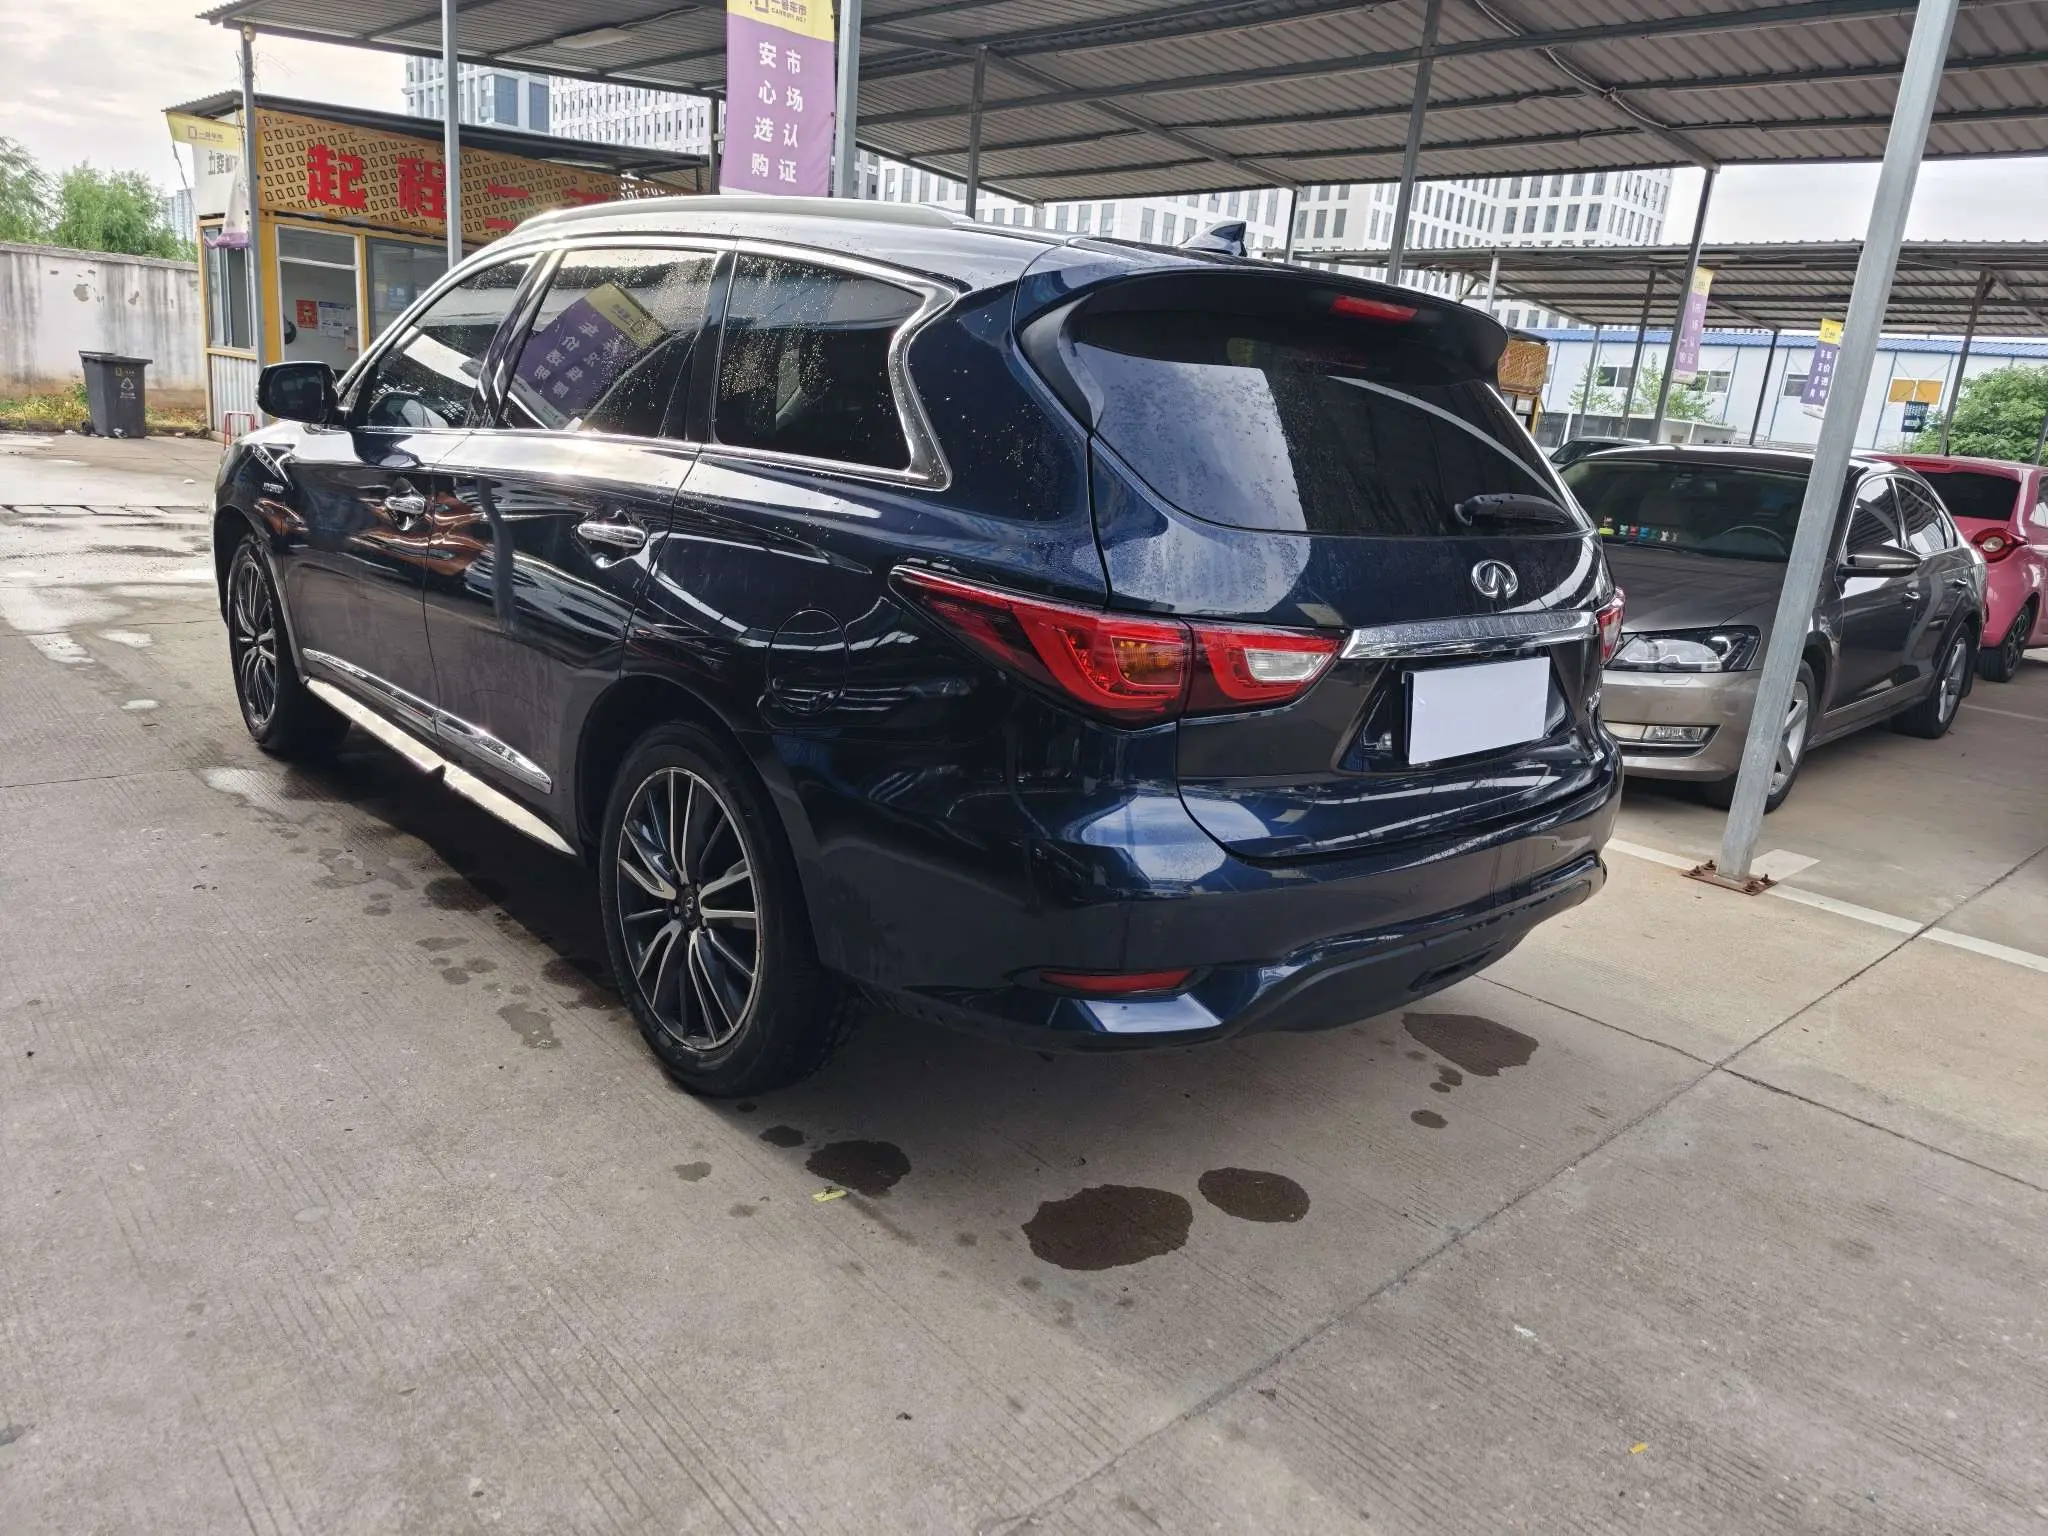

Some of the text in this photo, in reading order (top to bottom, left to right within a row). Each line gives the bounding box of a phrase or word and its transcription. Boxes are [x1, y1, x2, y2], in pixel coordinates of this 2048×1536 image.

[751, 41, 777, 178] 安心选购
[778, 49, 804, 183] 市场认证
